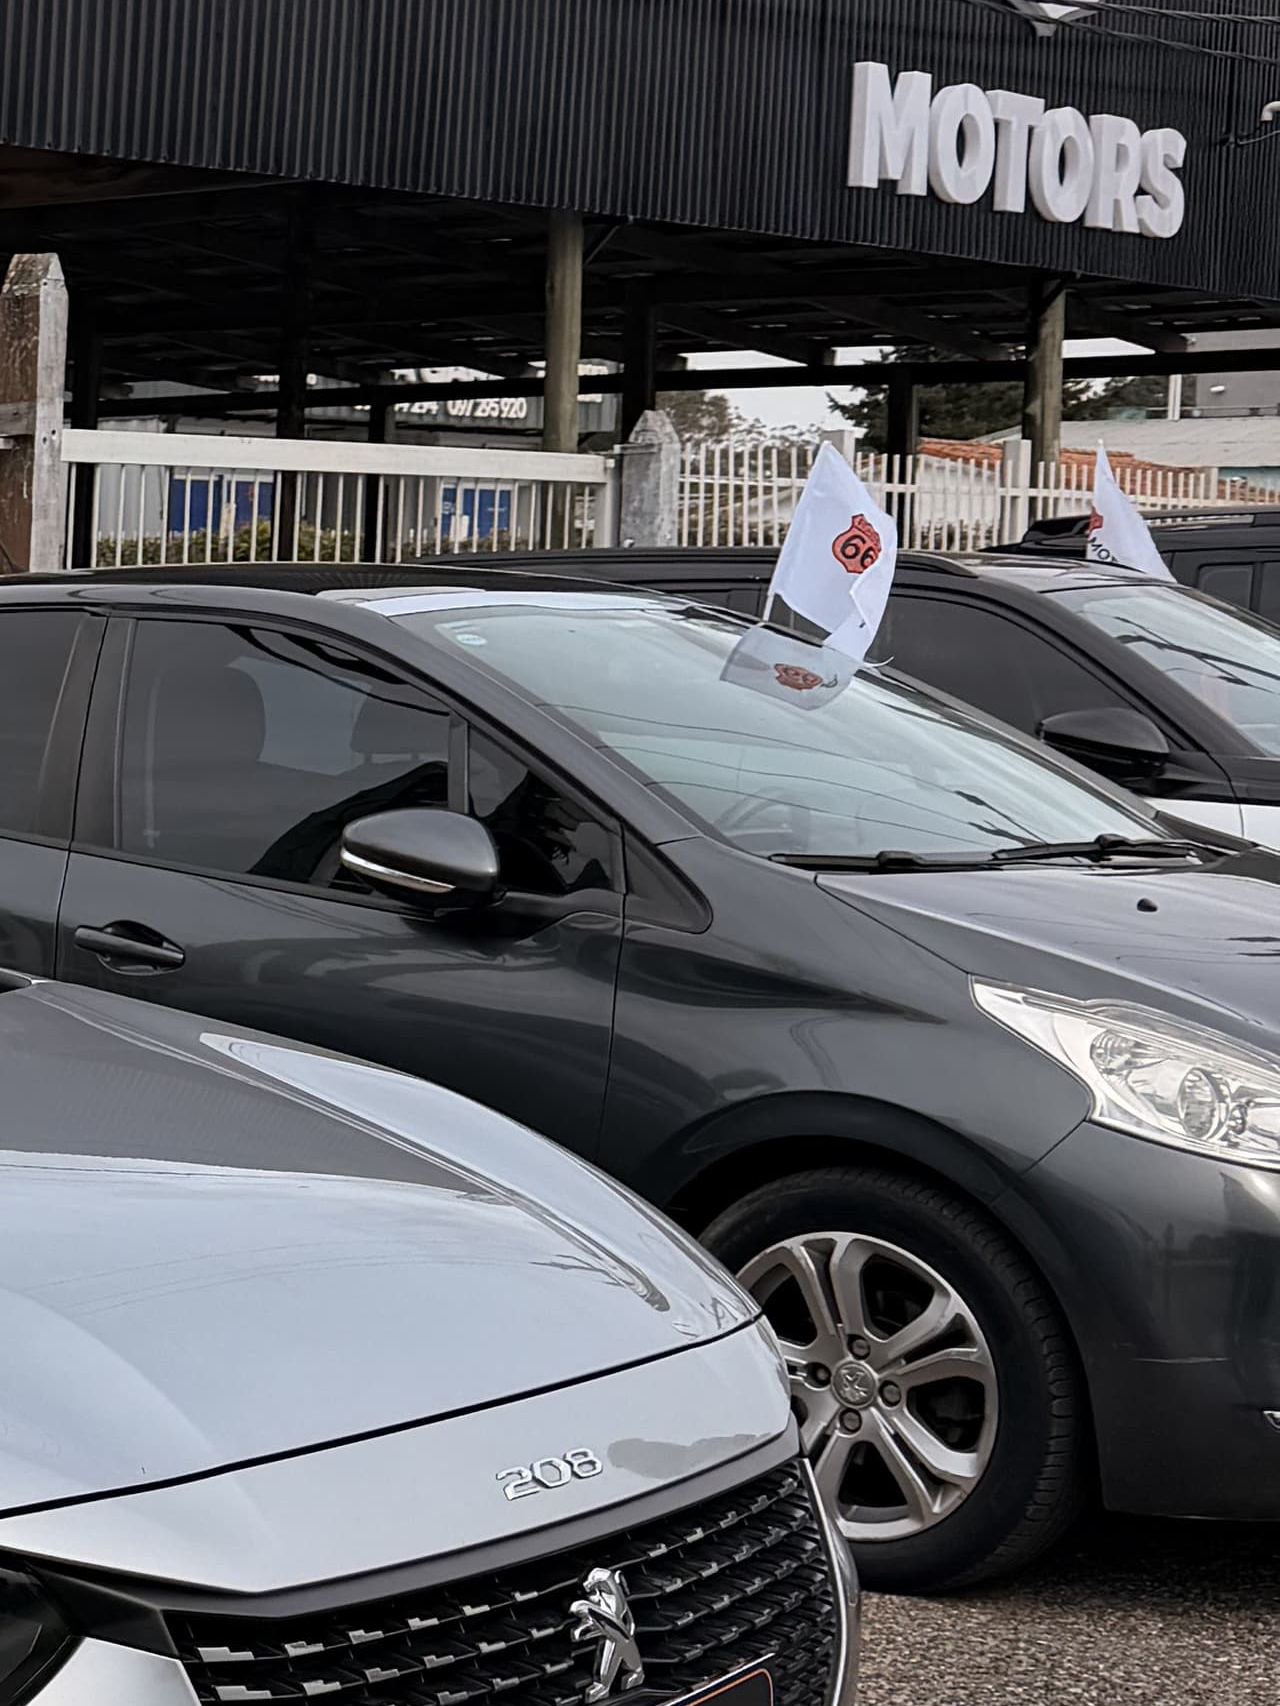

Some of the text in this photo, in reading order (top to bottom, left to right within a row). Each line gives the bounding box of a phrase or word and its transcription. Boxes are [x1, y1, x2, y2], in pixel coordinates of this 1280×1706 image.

[847, 61, 1187, 238] MOTORS
[841, 534, 877, 569] 66
[496, 1448, 603, 1501] 208
